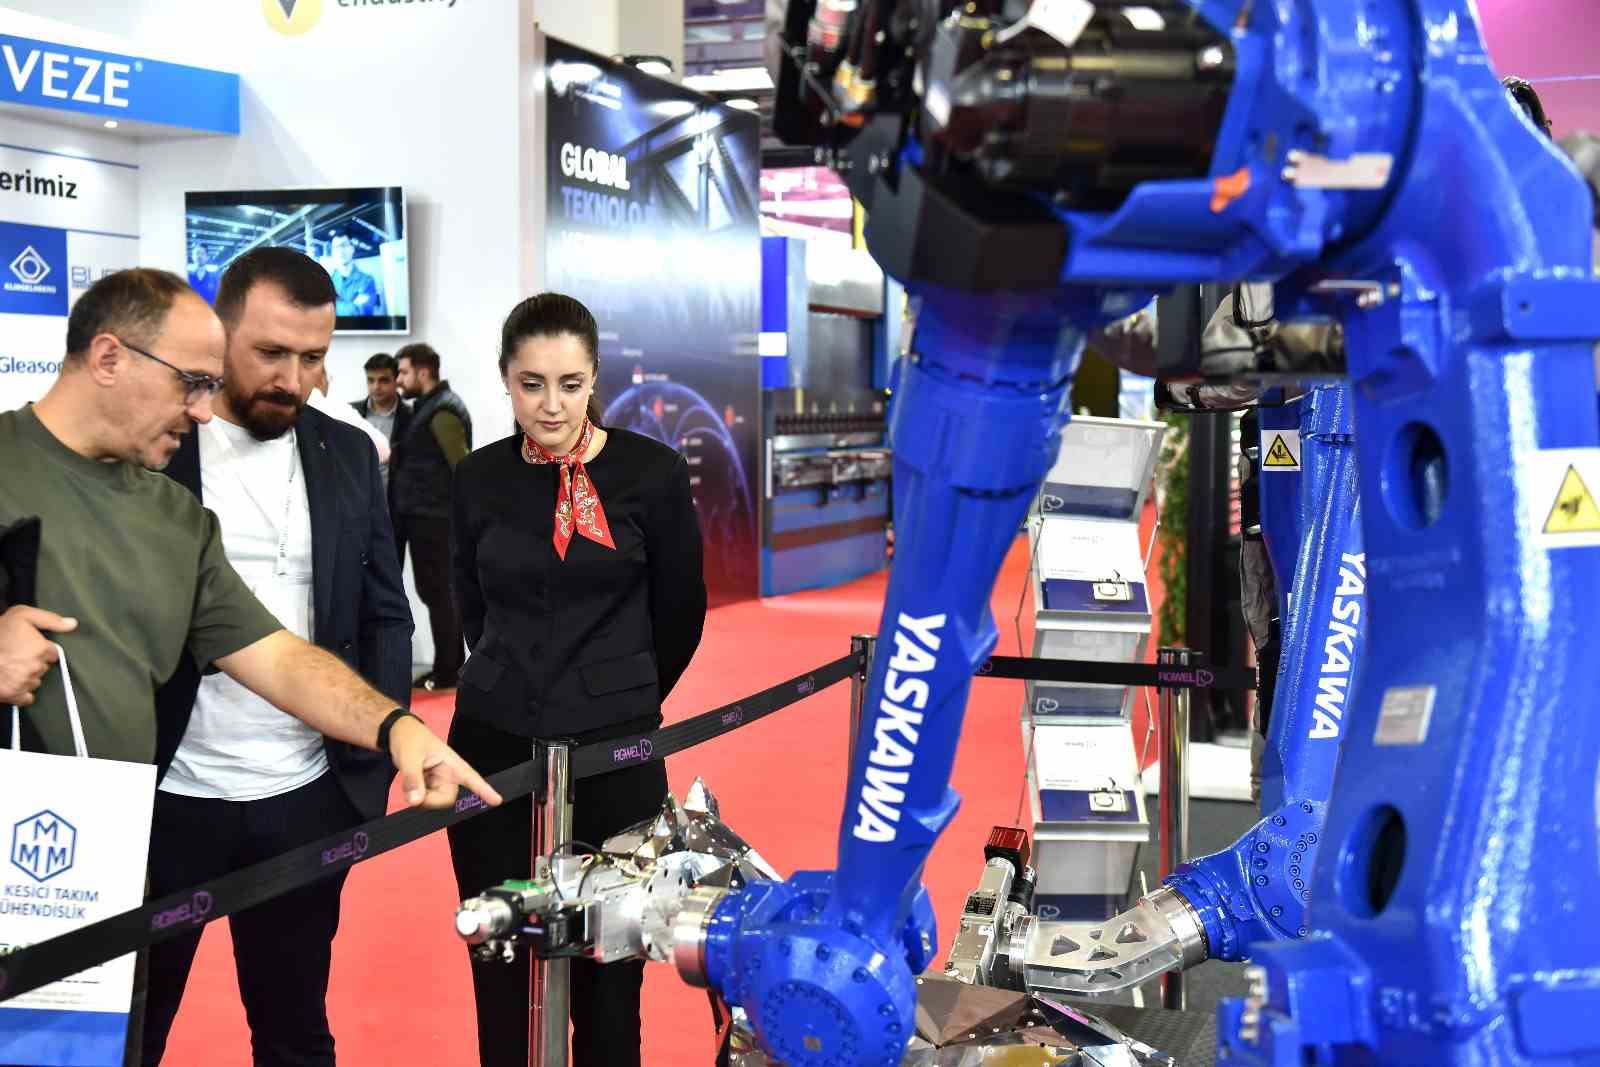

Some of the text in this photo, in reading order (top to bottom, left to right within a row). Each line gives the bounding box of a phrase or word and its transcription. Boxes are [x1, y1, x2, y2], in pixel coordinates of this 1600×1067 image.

[560, 142, 630, 191] GLOBAL
[852, 612, 947, 843] YASKAWA
[1308, 552, 1368, 740] YASKAWA
